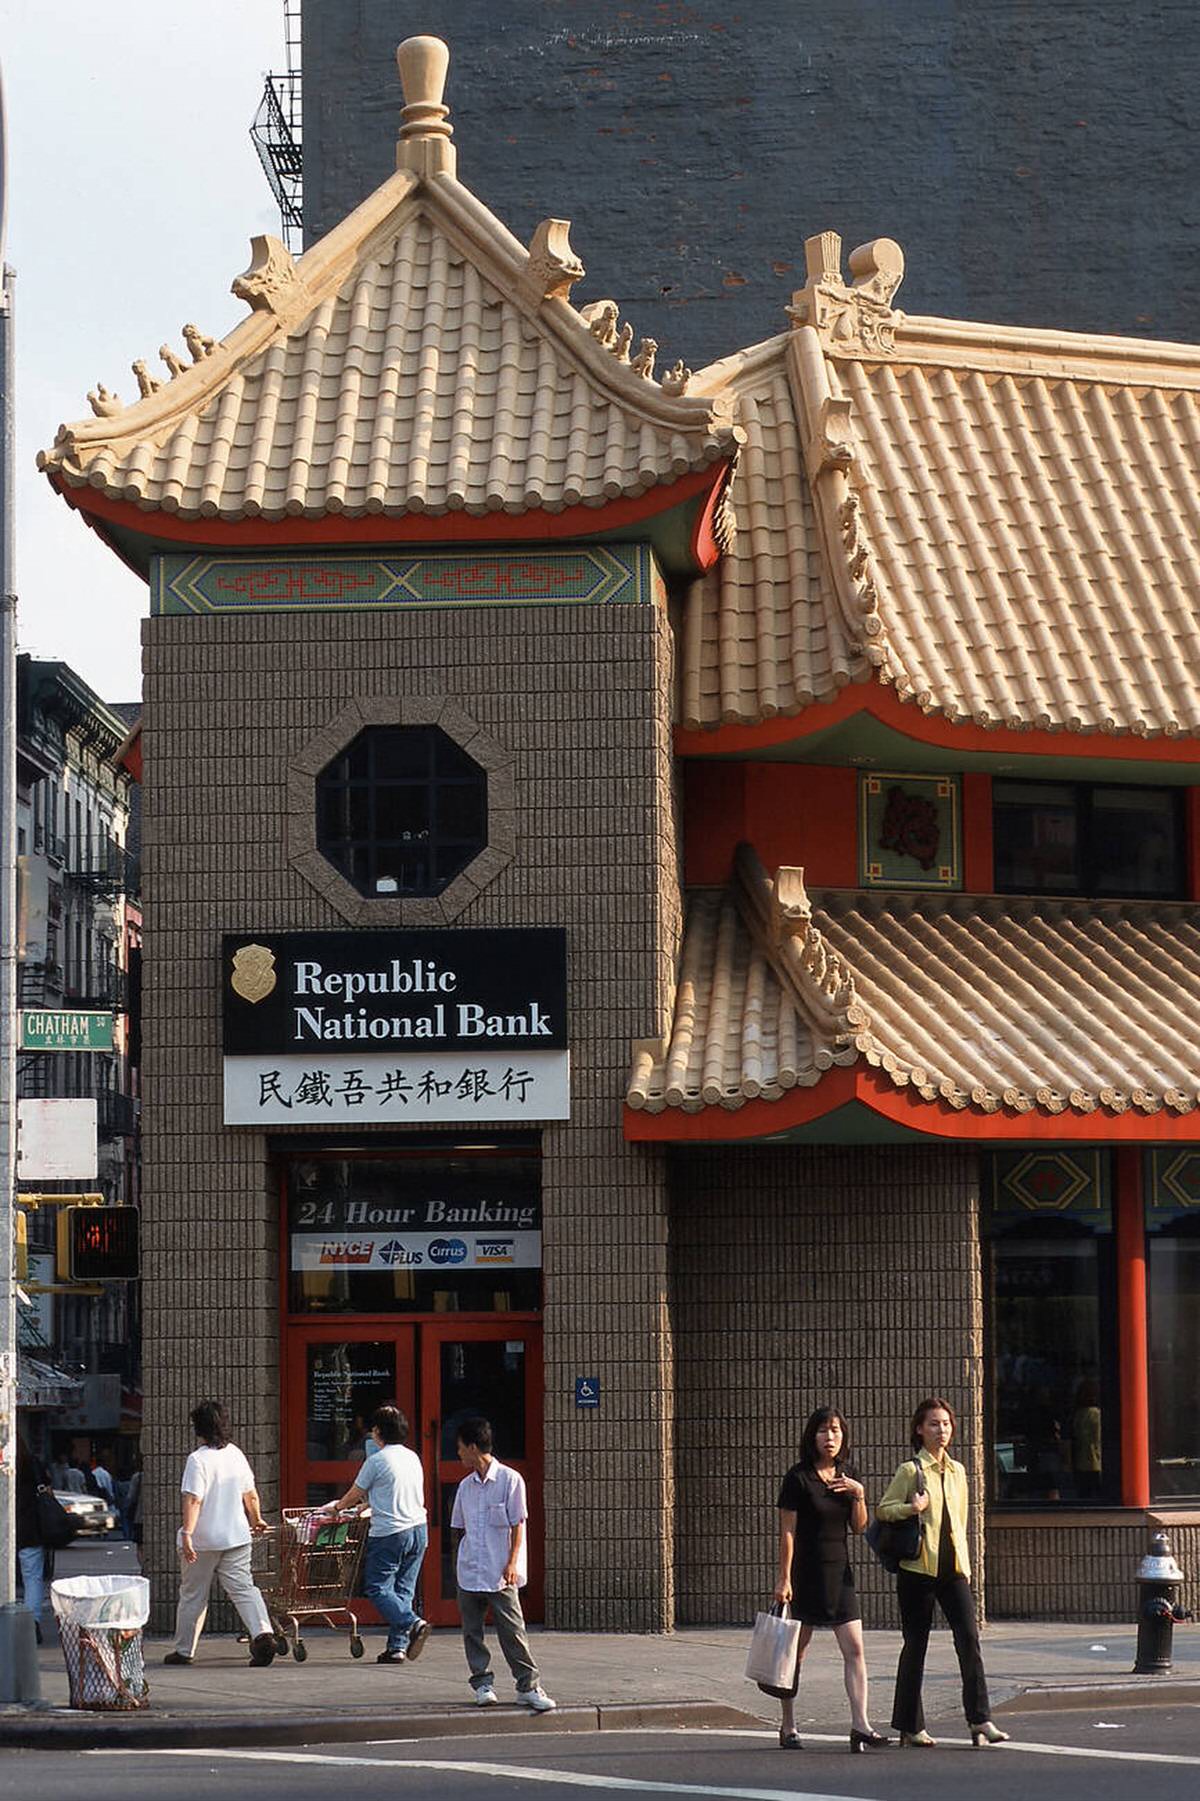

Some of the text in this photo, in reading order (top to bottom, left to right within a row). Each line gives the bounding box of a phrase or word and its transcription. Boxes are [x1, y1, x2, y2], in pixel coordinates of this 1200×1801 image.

[293, 960, 457, 1003] Republic
[27, 1015, 89, 1035] CHATHAM
[294, 1003, 553, 1040] National Bank
[258, 1067, 534, 1108] 民鐵吾共和銀行
[298, 1200, 537, 1228] 24 Hour Banking
[321, 1240, 509, 1265] NYCE PLUS Cirrus VISA
